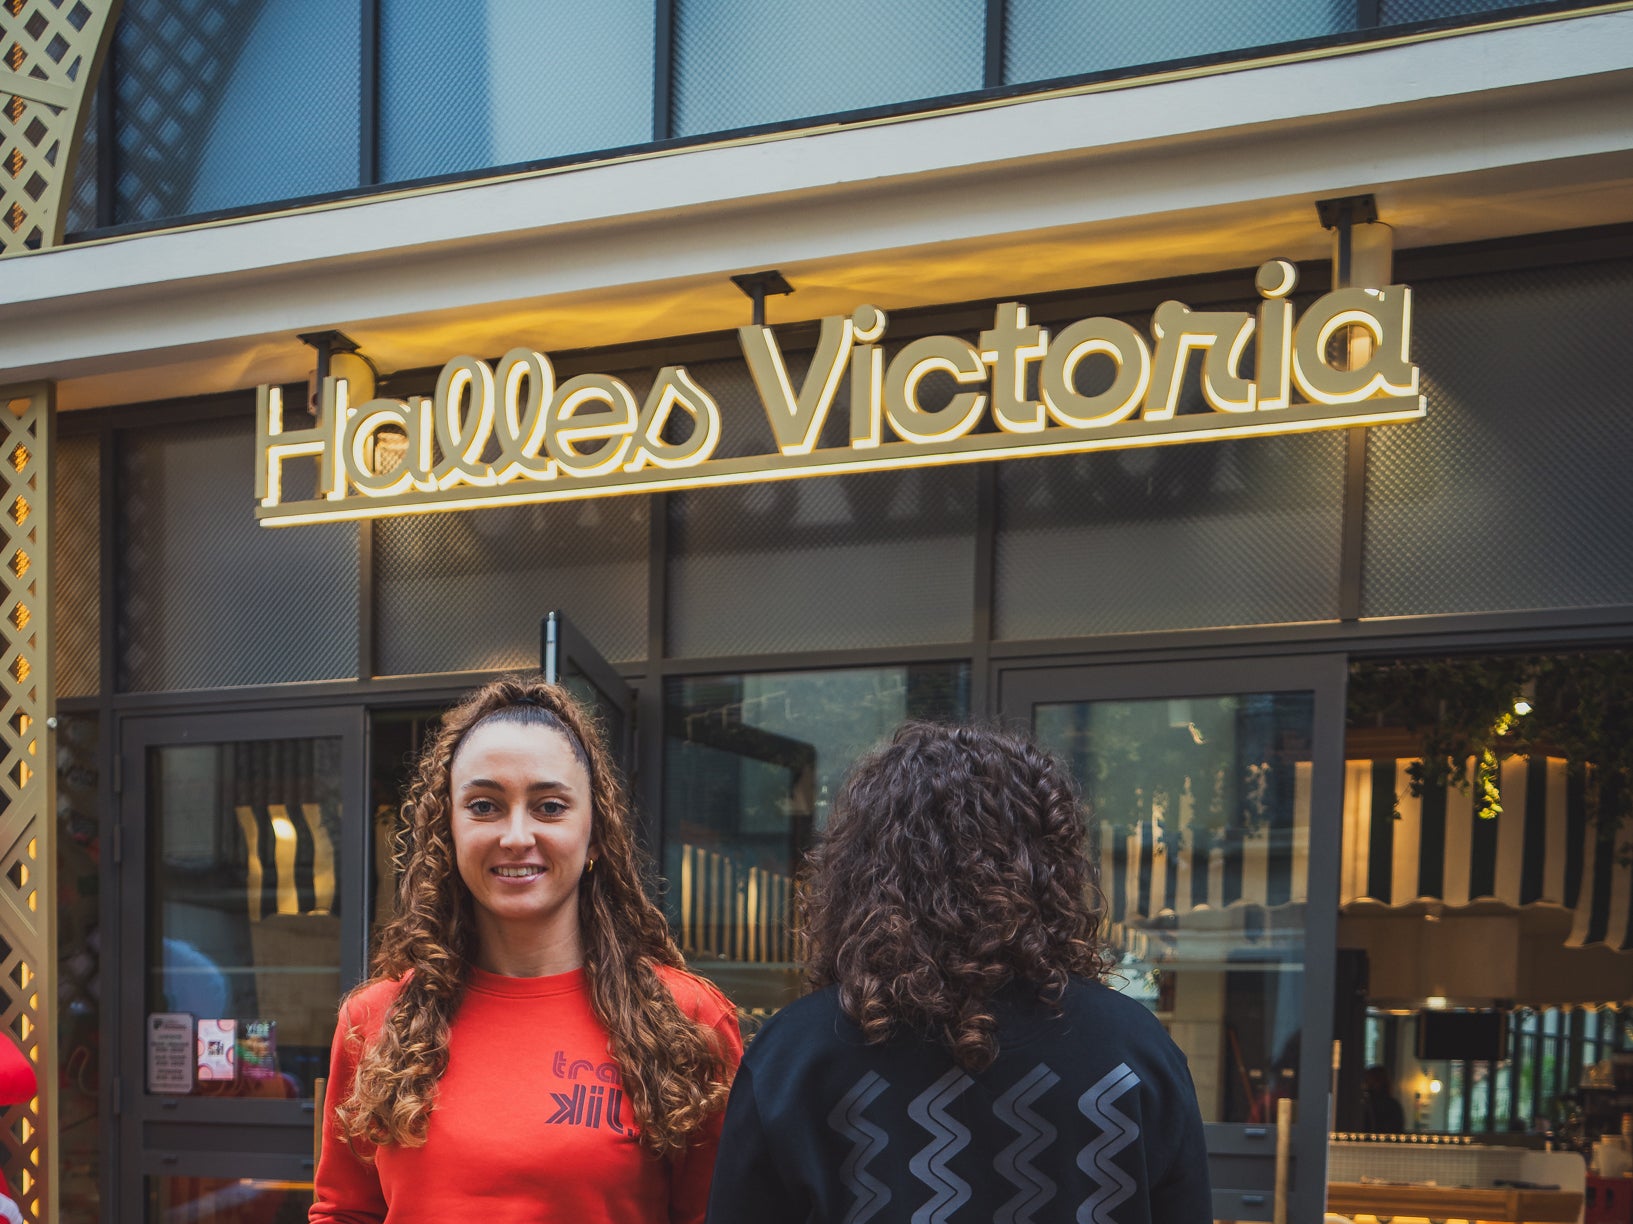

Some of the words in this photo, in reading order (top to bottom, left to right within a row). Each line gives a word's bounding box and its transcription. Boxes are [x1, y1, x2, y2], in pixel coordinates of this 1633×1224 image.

[255, 347, 723, 507] Halles
[738, 258, 1420, 456] Victoria
[552, 1050, 621, 1085] tra
